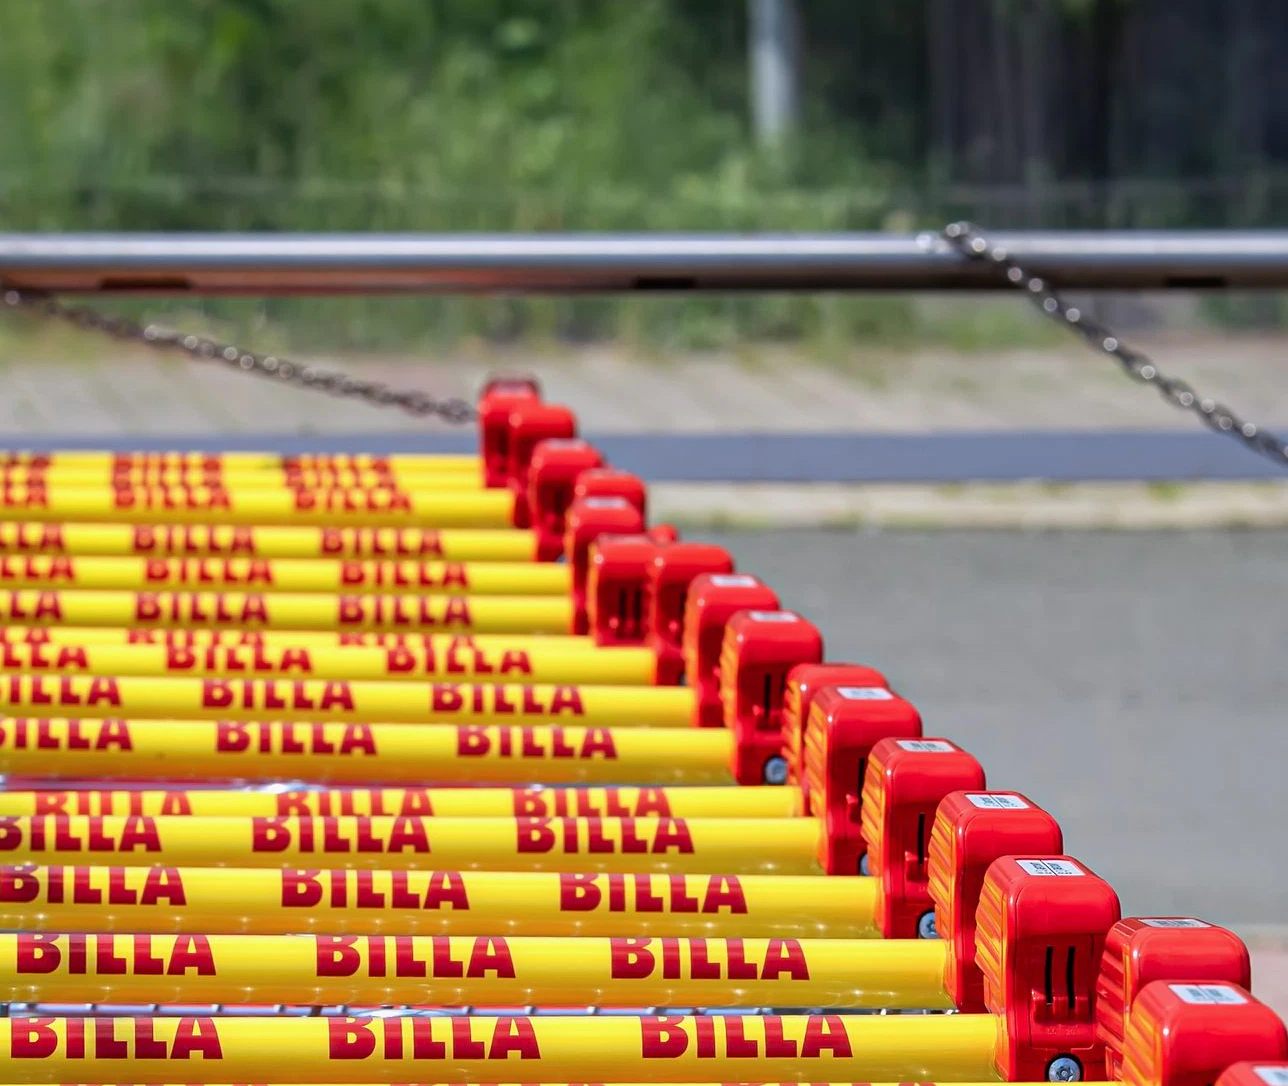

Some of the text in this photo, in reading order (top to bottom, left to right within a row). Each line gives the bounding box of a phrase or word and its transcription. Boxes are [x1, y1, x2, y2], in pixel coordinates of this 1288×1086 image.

[133, 524, 256, 556] BILLA
[320, 526, 444, 558] BILLA
[144, 558, 273, 586] BILLA
[341, 561, 469, 589] BILLA
[134, 593, 268, 626] BILLA
[338, 596, 472, 629] BILLA
[167, 646, 313, 673] BILLA
[388, 648, 532, 675] BILLA
[202, 679, 355, 712] BILLA
[432, 684, 585, 717] BILLA
[216, 722, 377, 756] BILLA
[457, 726, 618, 760] BILLA
[513, 788, 672, 817] BILLA
[252, 816, 431, 853] BILLA
[516, 817, 695, 854] BILLA
[281, 869, 469, 910] BILLA
[559, 873, 748, 914] BILLA
[16, 934, 810, 981] BILLA BILLA BILLA
[11, 1015, 853, 1060] BILLA BILLA BILLA
